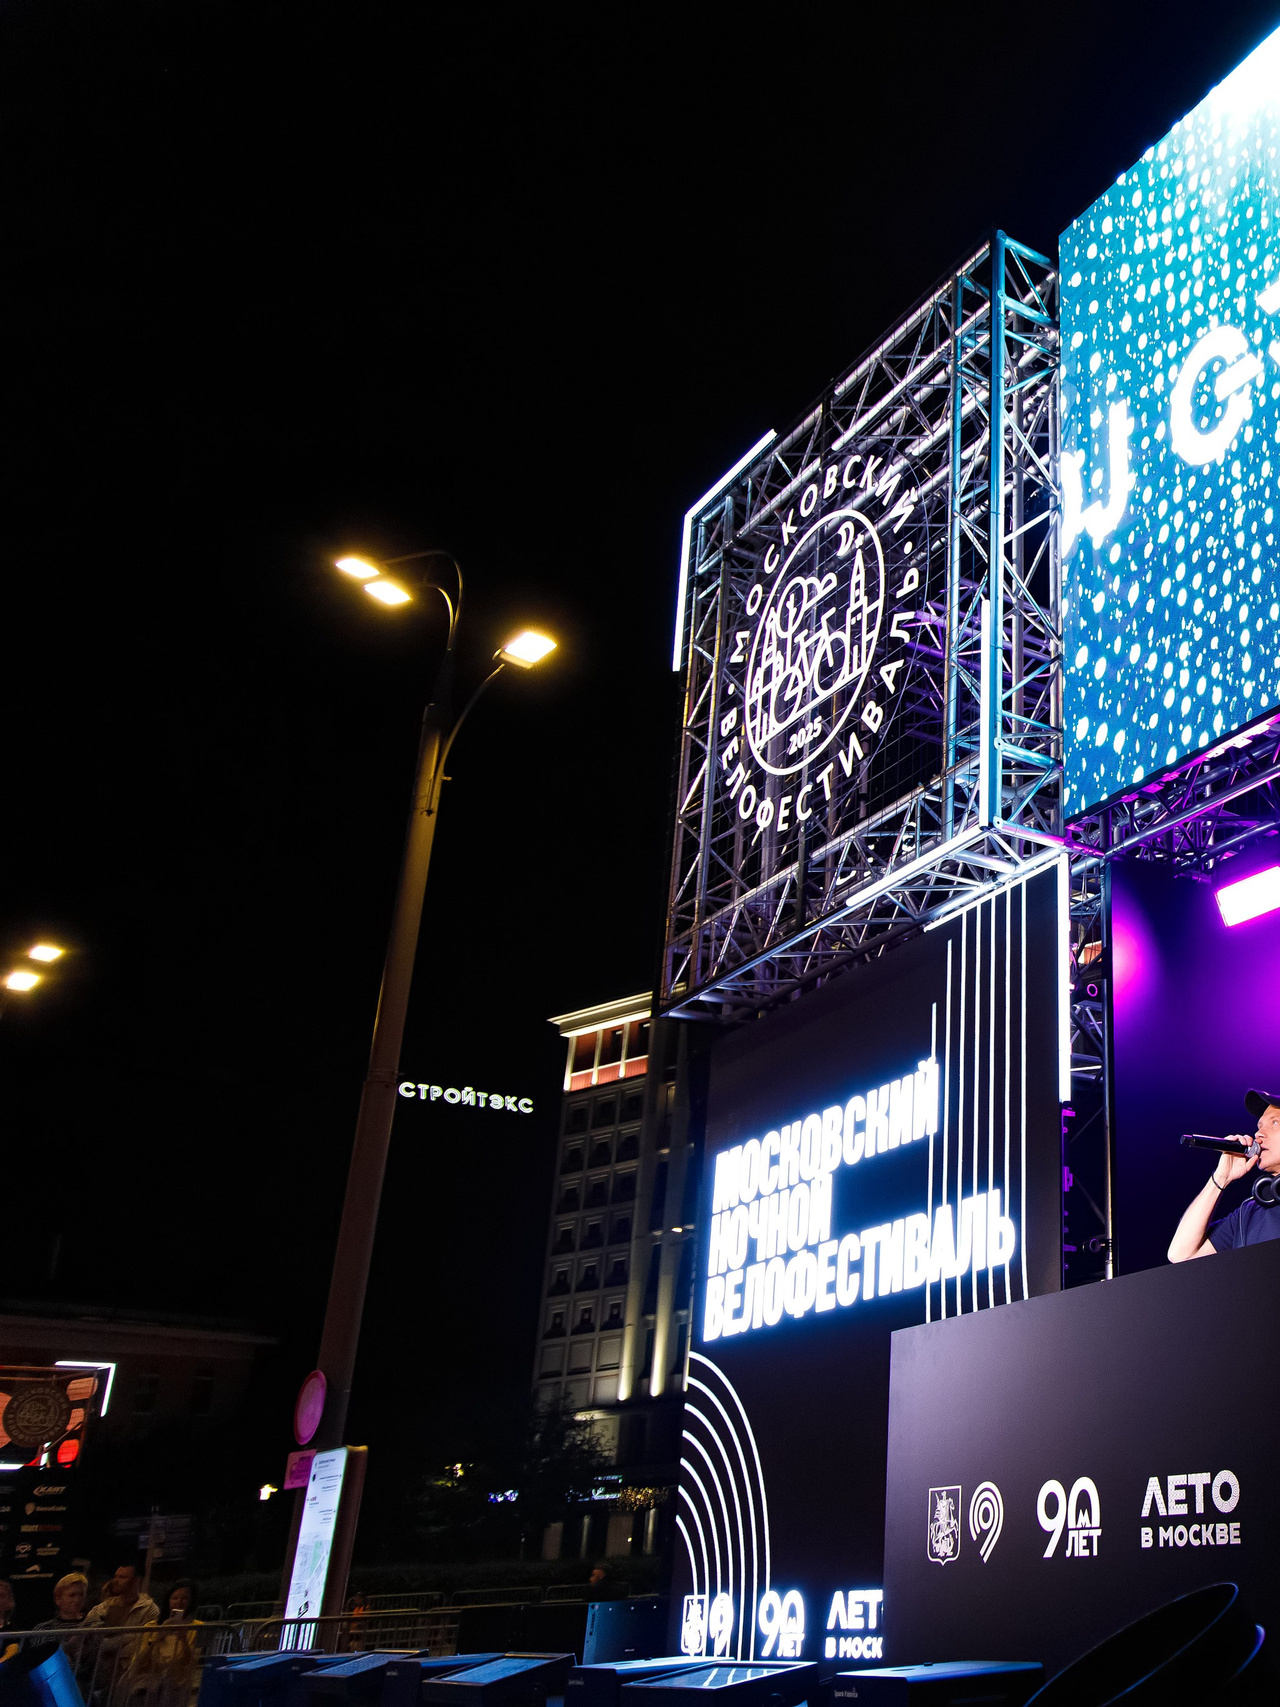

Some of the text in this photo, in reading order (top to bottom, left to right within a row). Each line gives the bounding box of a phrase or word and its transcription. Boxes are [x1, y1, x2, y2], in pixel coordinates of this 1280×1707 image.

[730, 454, 918, 664] МОСКОВСКИЙ
[720, 567, 919, 832] ВЕЛОФЕСТИВАЛЬ
[788, 715, 822, 756] 2025
[398, 1081, 534, 1114] СТРОЙТЭКС
[712, 1056, 939, 1214] МОСКОВСКИЙ
[707, 1168, 833, 1278] НОЧНОЙ
[703, 1187, 1016, 1342] ВЕЛОФЕСТИВАЛЬ
[1140, 1469, 1240, 1518] ЛЕТО
[1065, 1528, 1102, 1558] ЛЕТ
[1140, 1521, 1242, 1549] В МОСКВЕ
[826, 1589, 884, 1630] ЛЕТ
[776, 1632, 806, 1658] ЛЕТ
[825, 1636, 837, 1659] В
